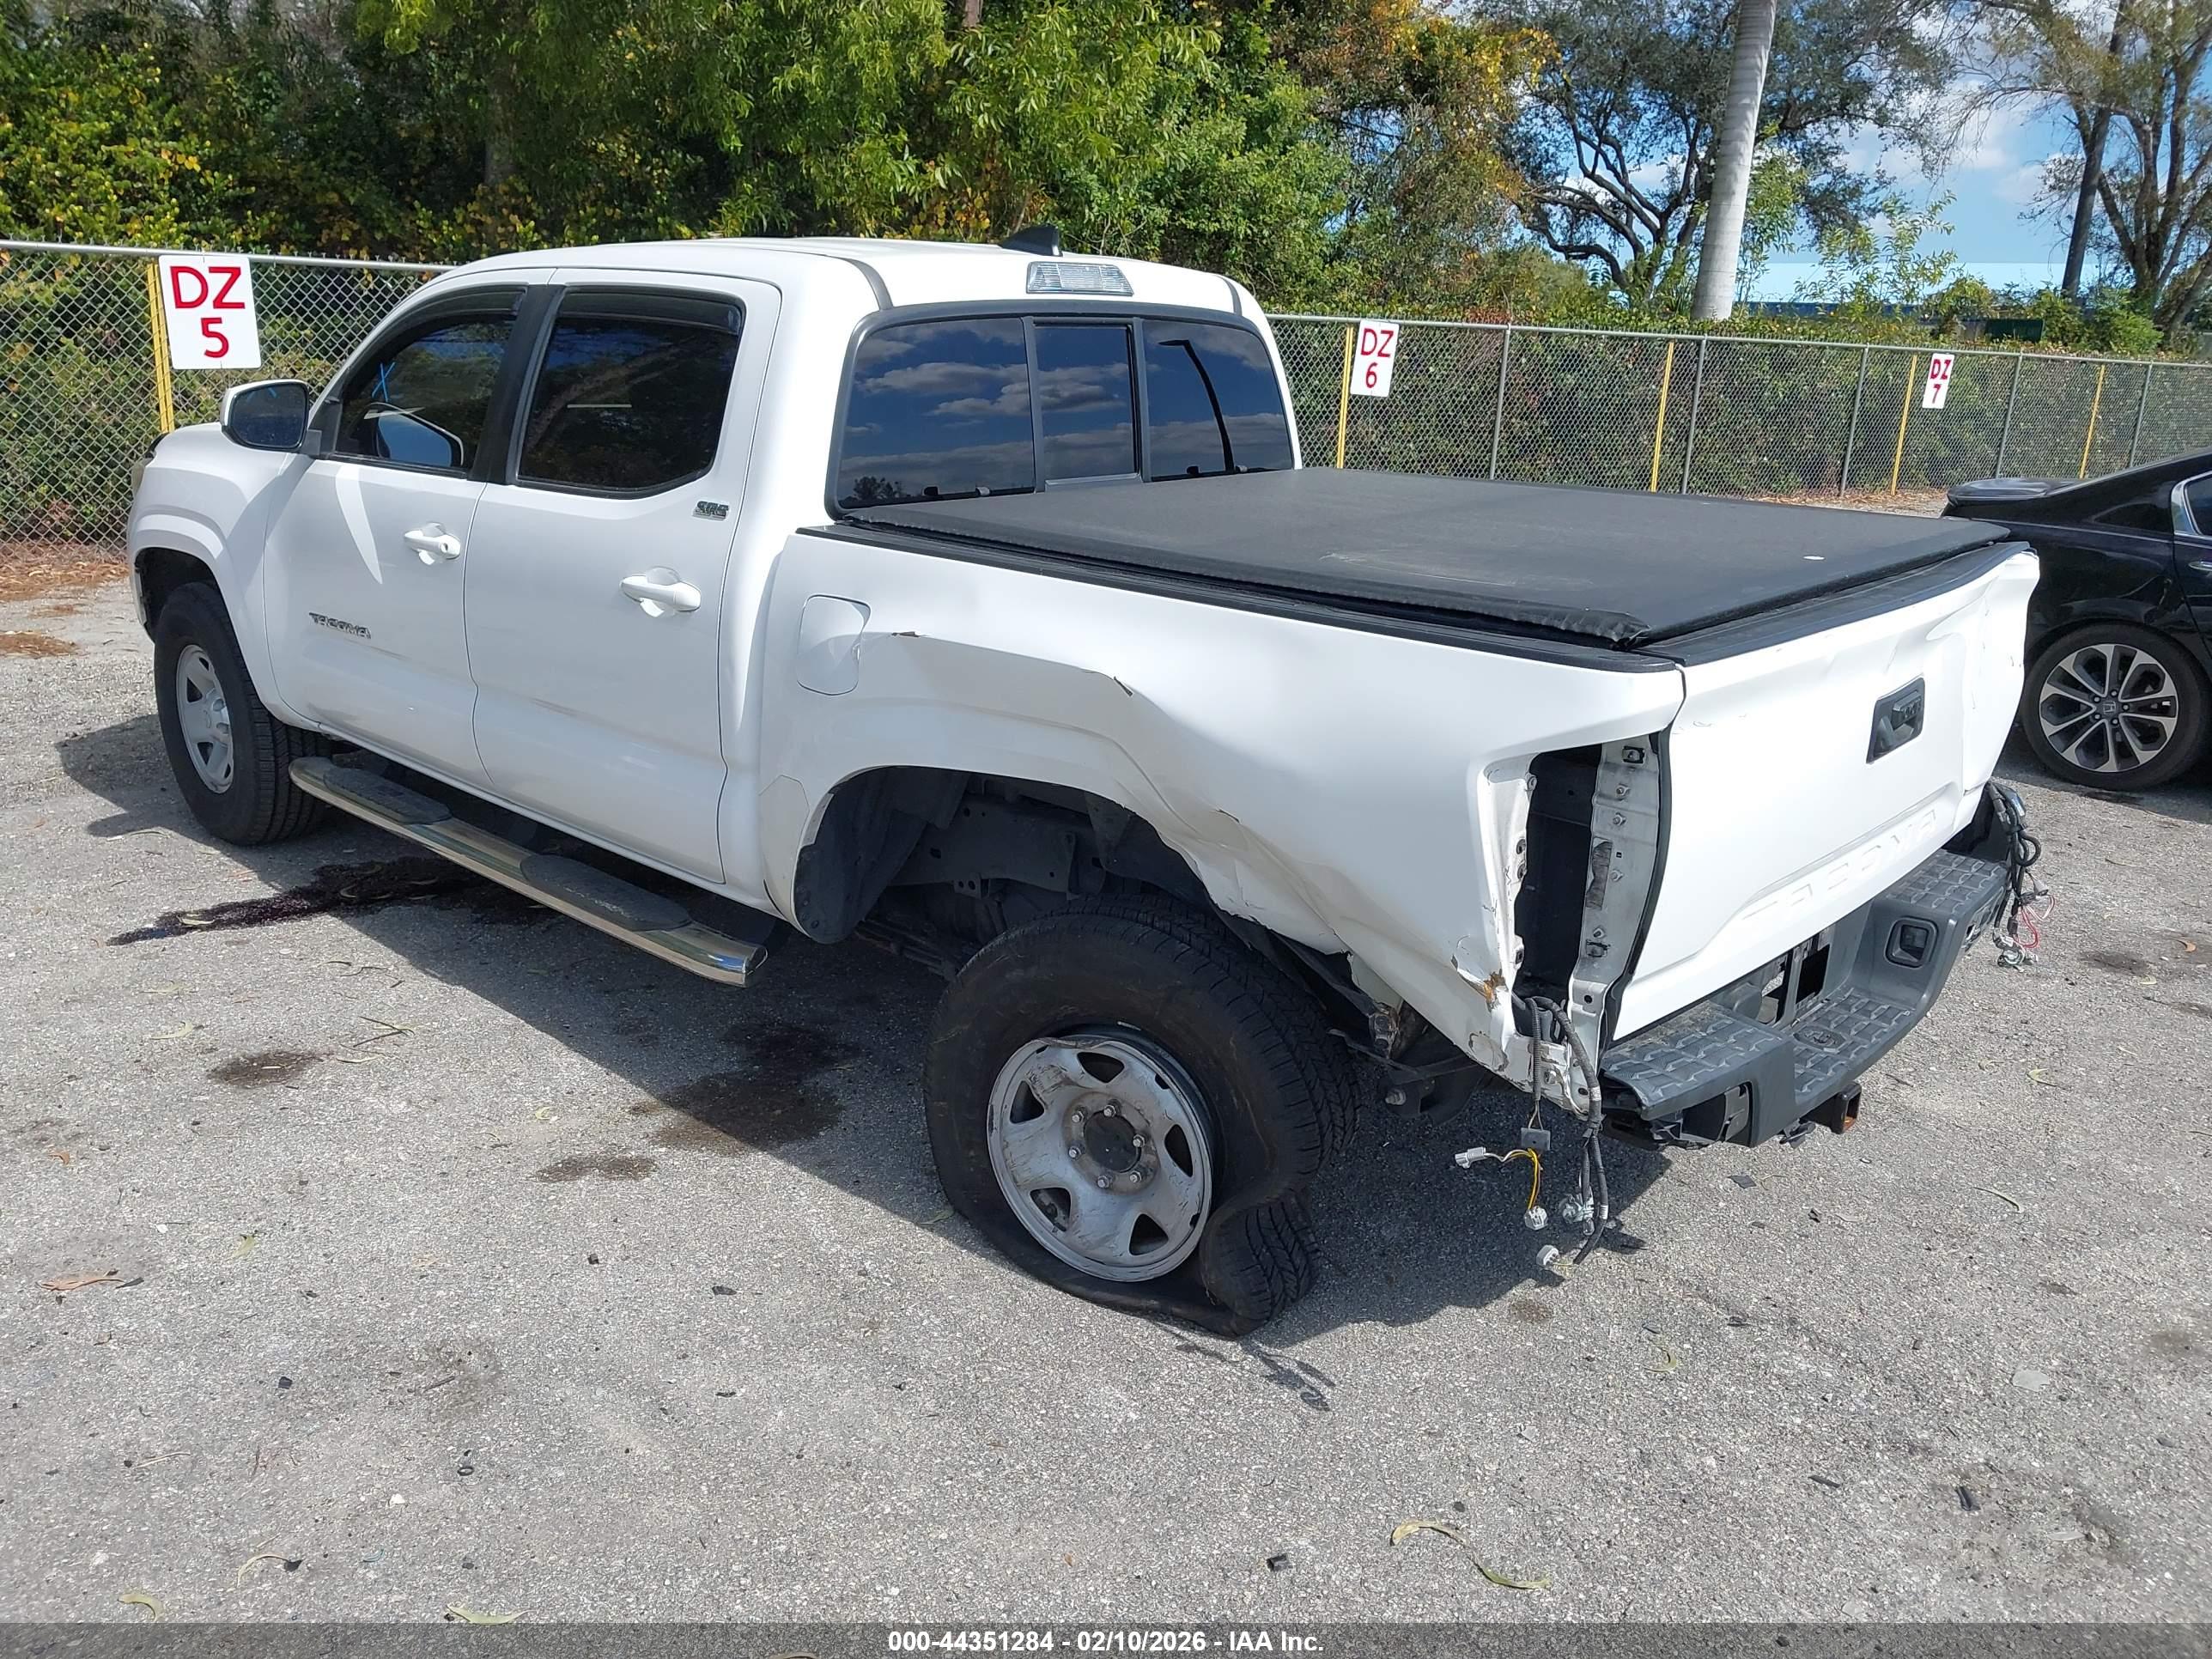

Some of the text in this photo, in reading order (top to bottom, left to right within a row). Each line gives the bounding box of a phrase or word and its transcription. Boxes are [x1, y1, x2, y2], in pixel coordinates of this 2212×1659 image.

[170, 265, 246, 309] DZ
[200, 317, 229, 358] 5
[1360, 327, 1394, 358] DZ
[1365, 362, 1378, 389] 6
[1929, 358, 1952, 380] DZ
[1932, 383, 1942, 404] 7
[308, 611, 372, 640] TACOMA
